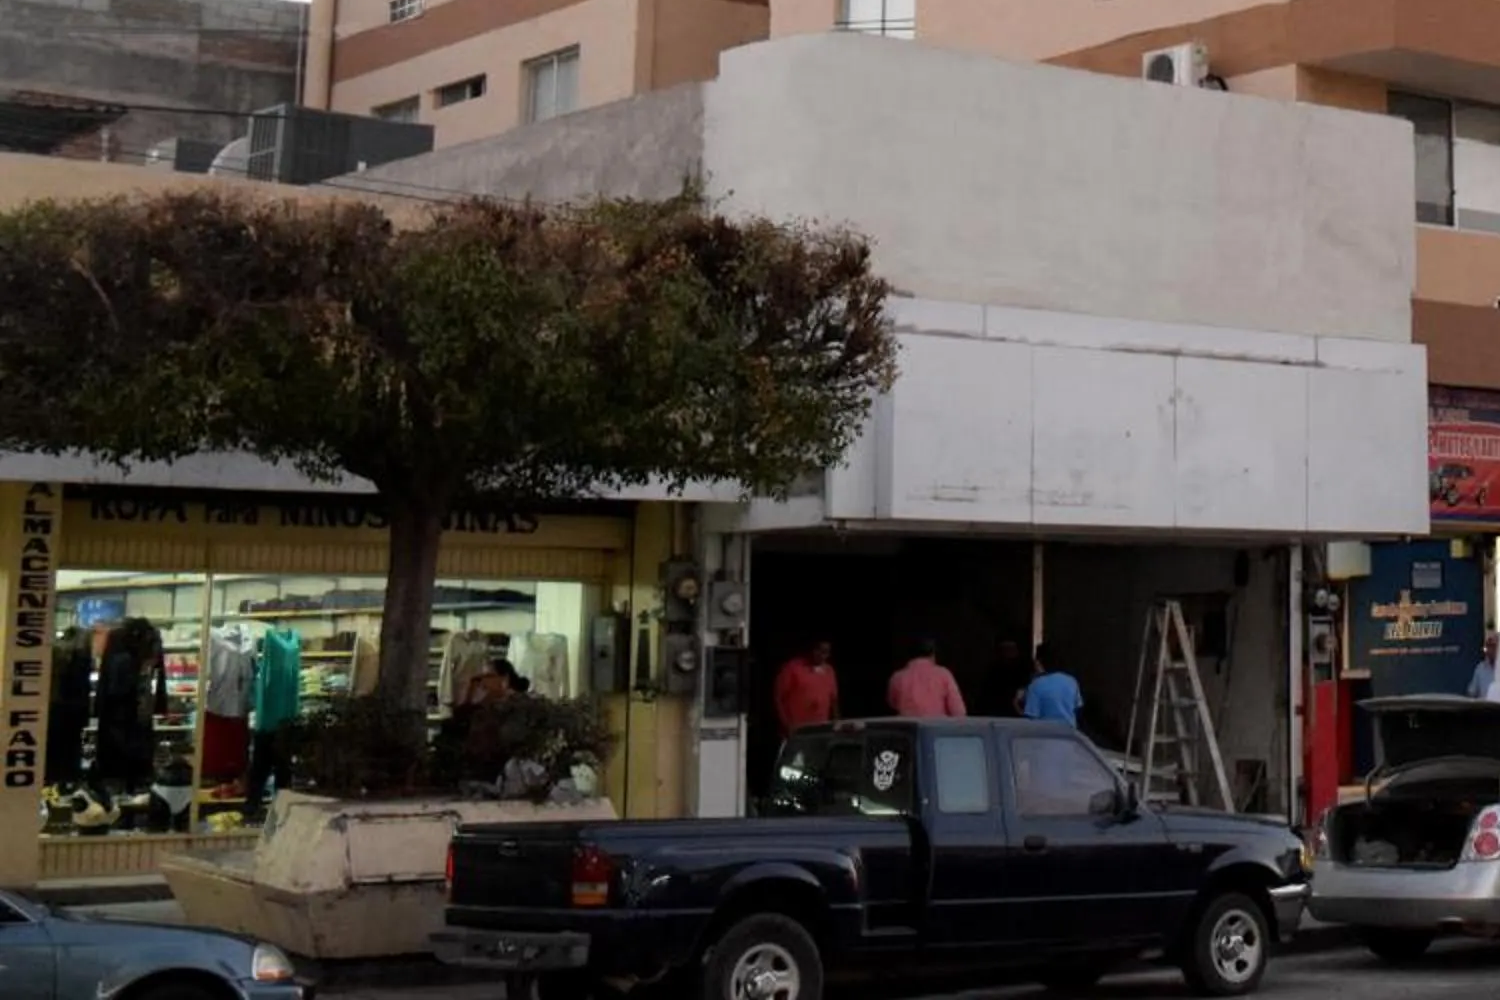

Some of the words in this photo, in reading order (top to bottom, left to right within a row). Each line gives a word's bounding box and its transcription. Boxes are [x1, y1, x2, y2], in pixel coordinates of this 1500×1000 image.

[15, 481, 54, 648] ALMACENES
[12, 661, 42, 697] EL
[5, 710, 39, 788] FARO
